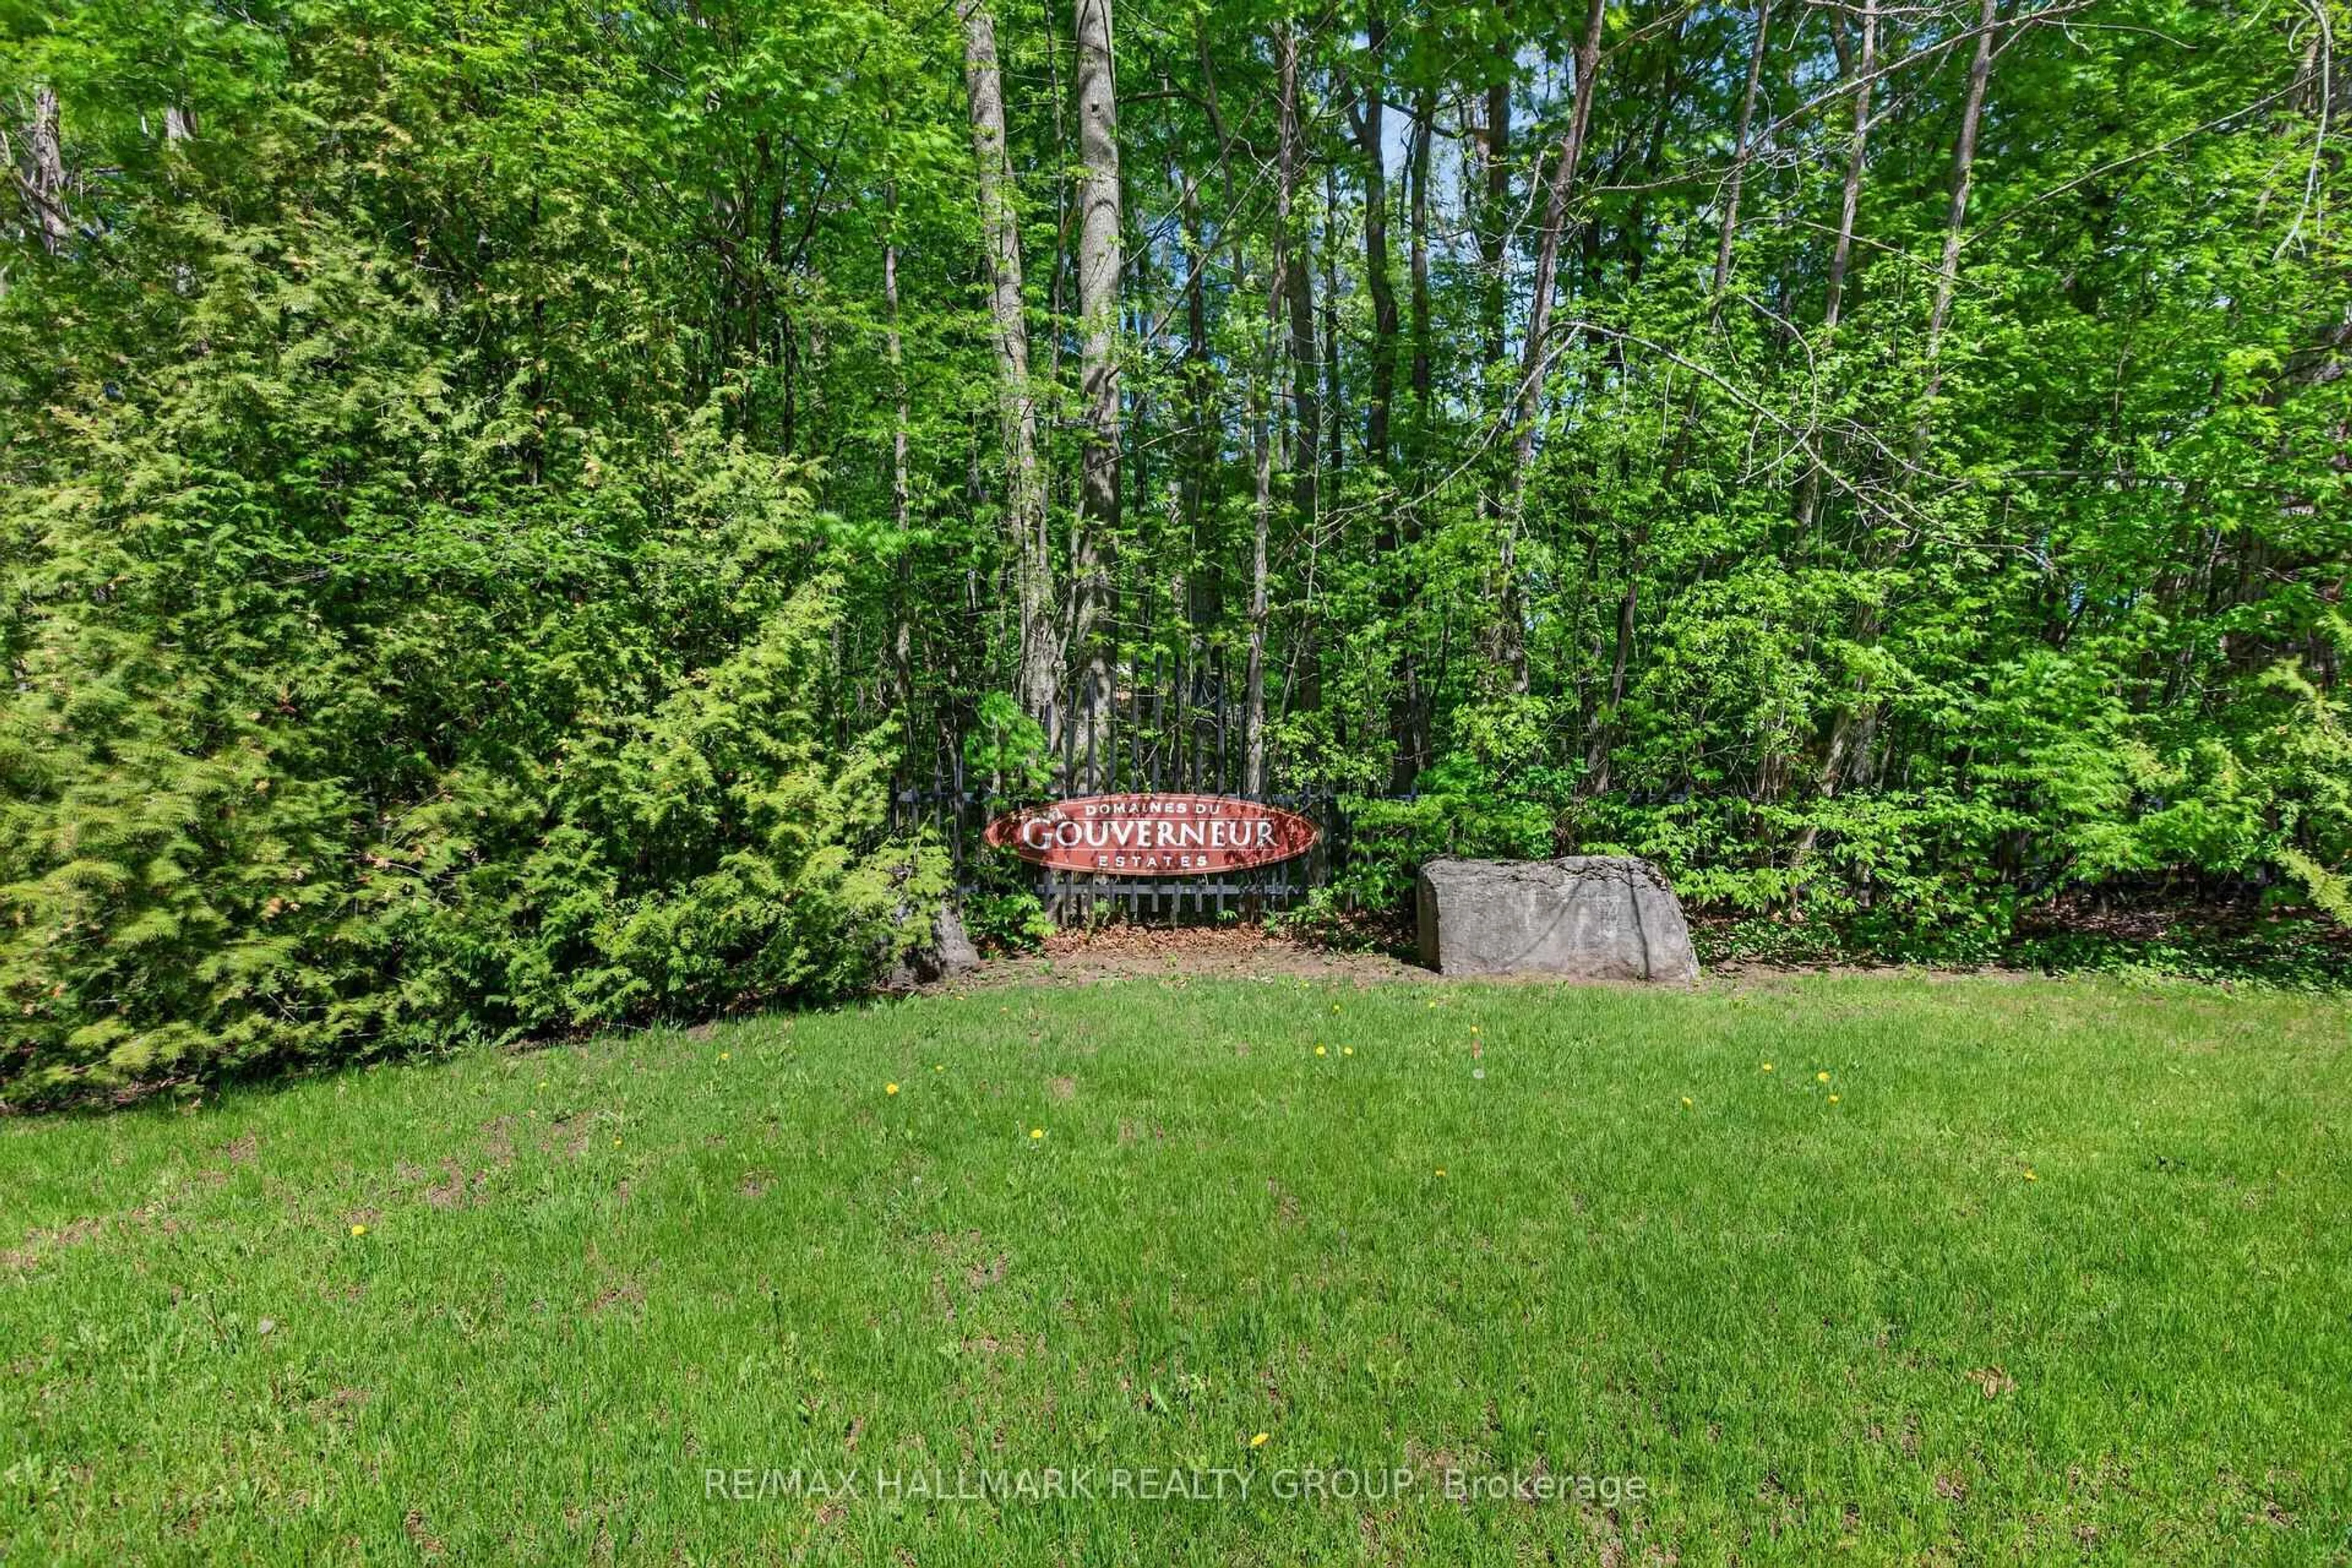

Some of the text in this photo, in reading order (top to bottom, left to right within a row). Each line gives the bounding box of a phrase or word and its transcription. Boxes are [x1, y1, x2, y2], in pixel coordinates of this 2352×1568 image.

[1085, 802, 1221, 816] DOMAINES DU
[1022, 819, 1279, 850] GOUVERNEUR
[1098, 856, 1208, 868] ESTATES
